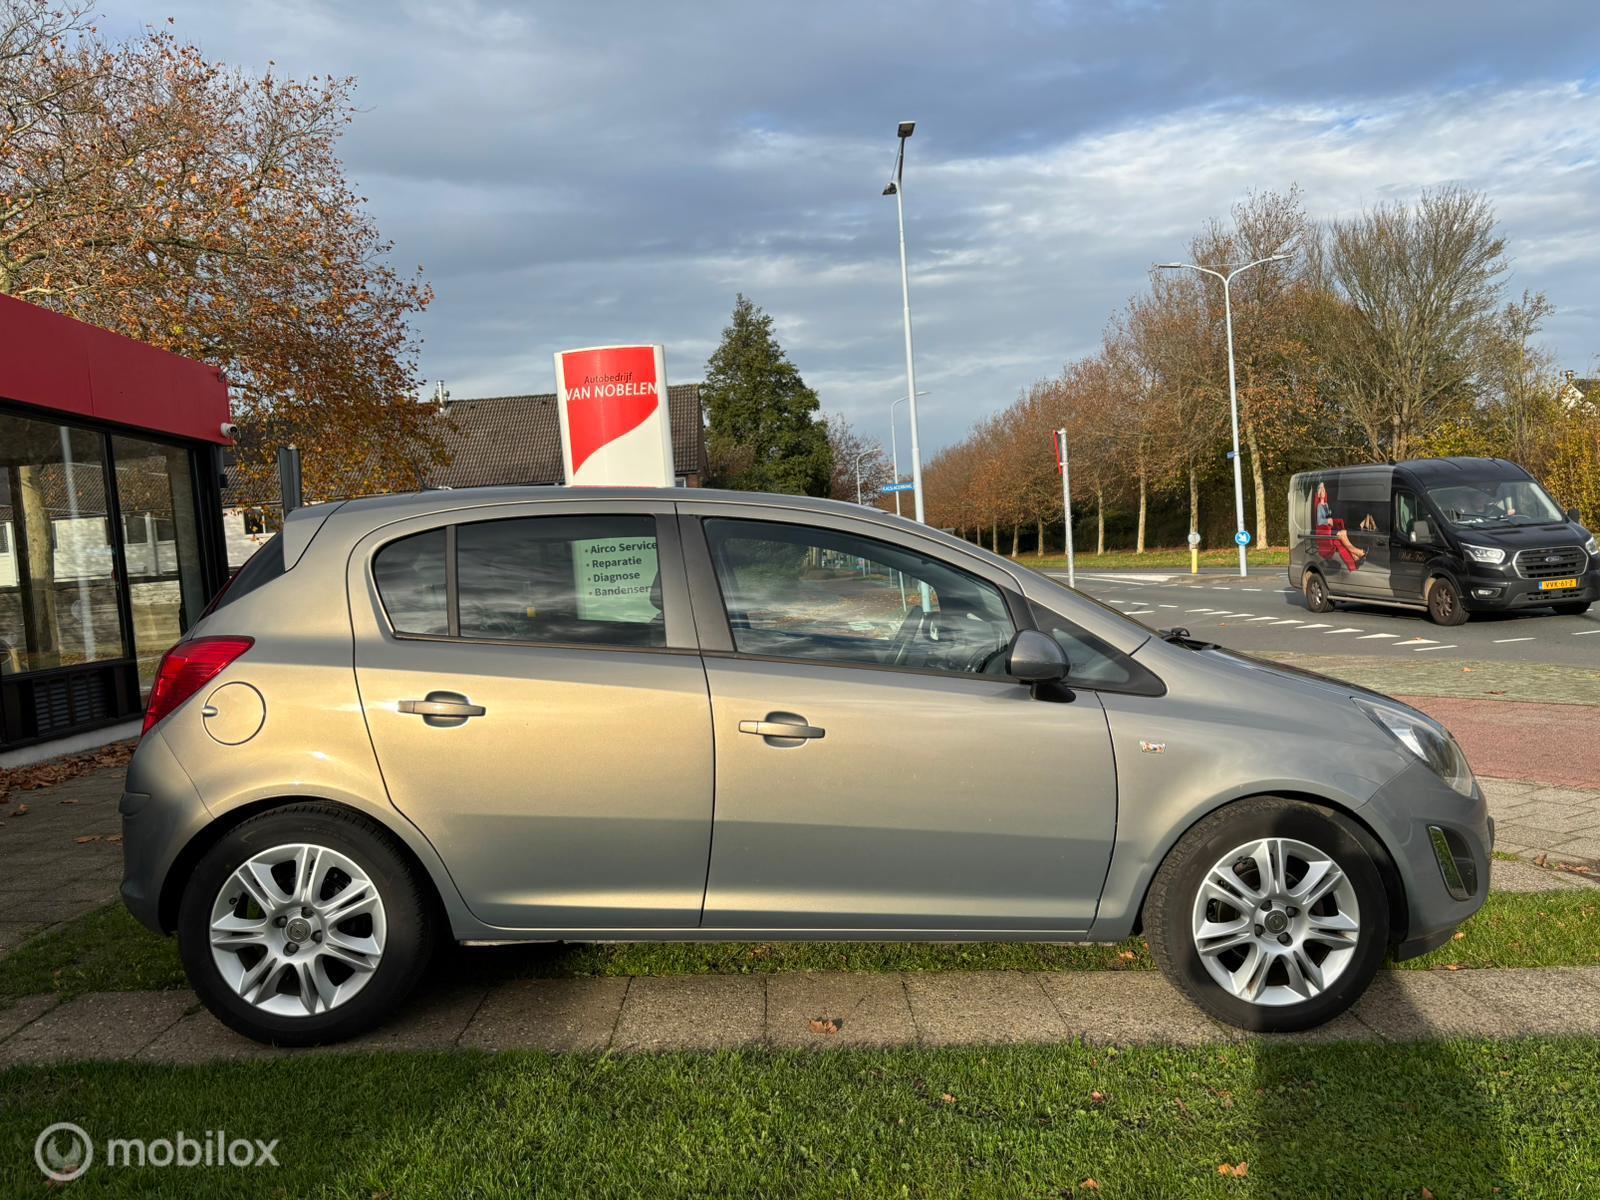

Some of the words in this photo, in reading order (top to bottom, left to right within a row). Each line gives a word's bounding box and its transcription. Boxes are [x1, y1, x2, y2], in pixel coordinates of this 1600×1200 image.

[584, 372, 633, 384] Autobedrijf
[565, 386, 591, 401] VAN
[594, 381, 658, 398] NOBELEN
[590, 544, 617, 554] Airco
[618, 540, 658, 552] Service
[592, 556, 642, 569] Reparatie
[593, 571, 641, 583] Diagnose
